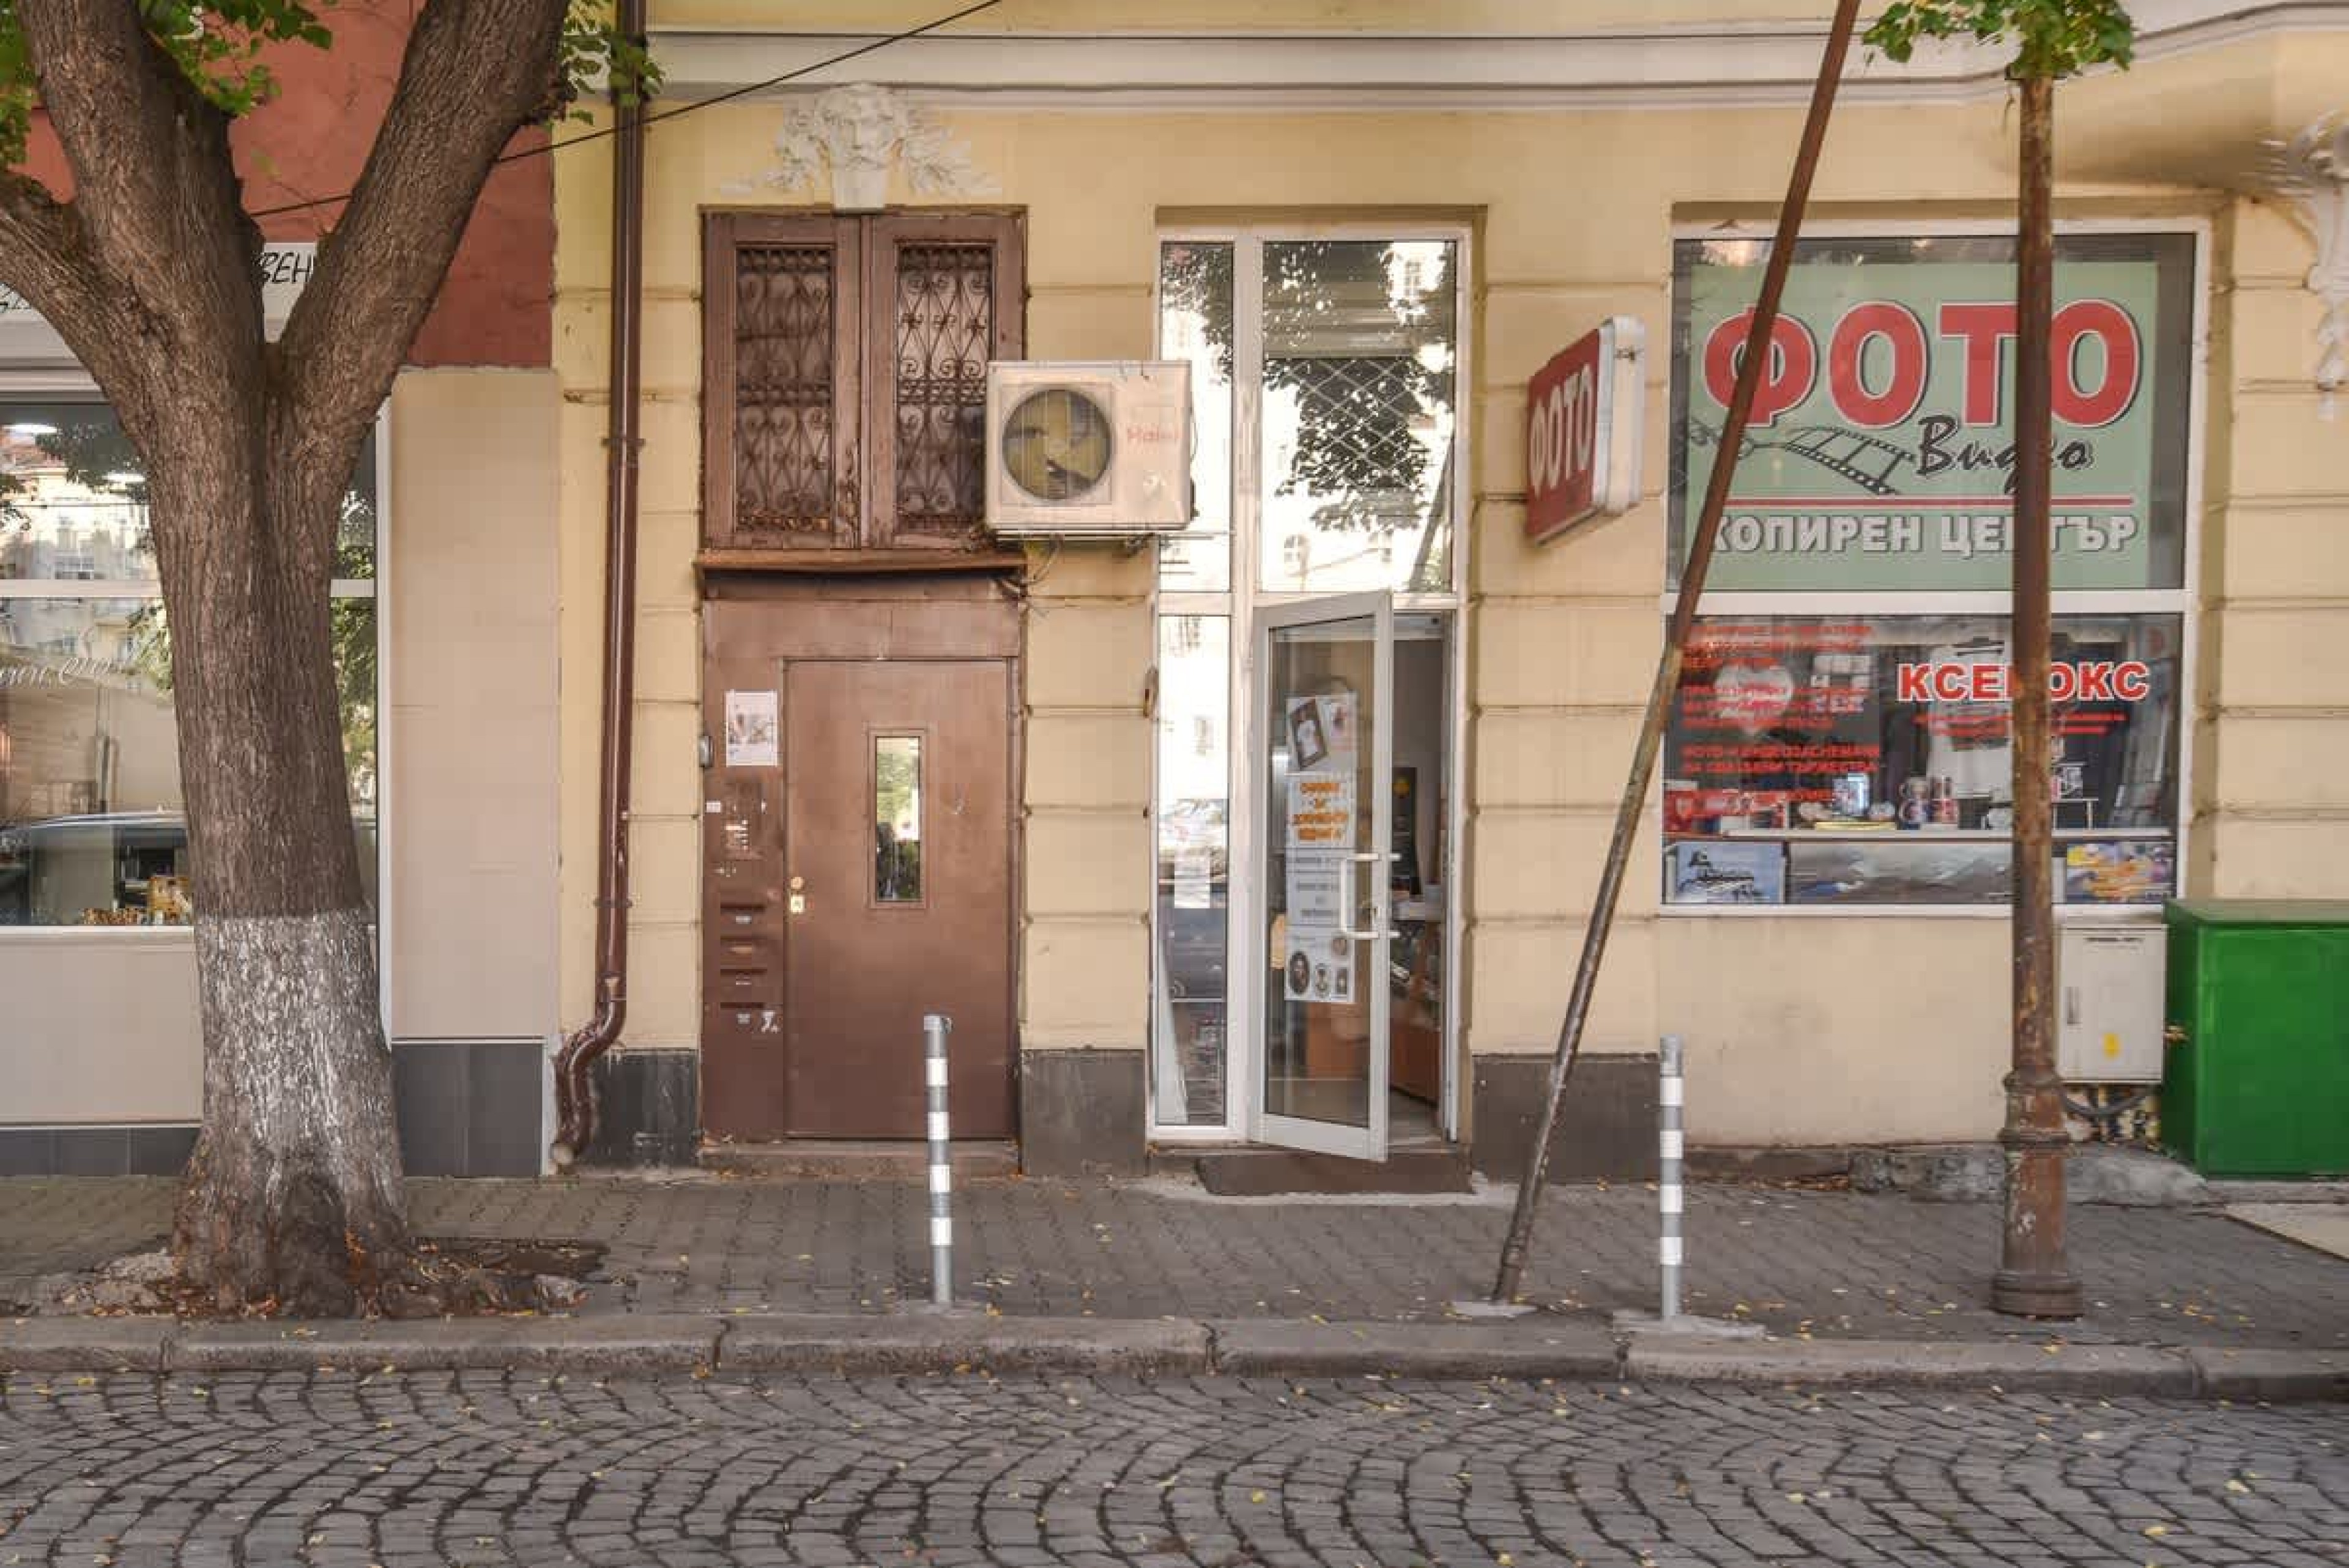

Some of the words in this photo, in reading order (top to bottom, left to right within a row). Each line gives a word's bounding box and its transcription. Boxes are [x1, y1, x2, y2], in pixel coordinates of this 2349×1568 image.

[1704, 299, 2140, 428] ФОТО
[1530, 363, 1593, 500] ФОТО
[1917, 414, 2088, 494] Видо
[1897, 661, 2151, 702] КСЕОКС
